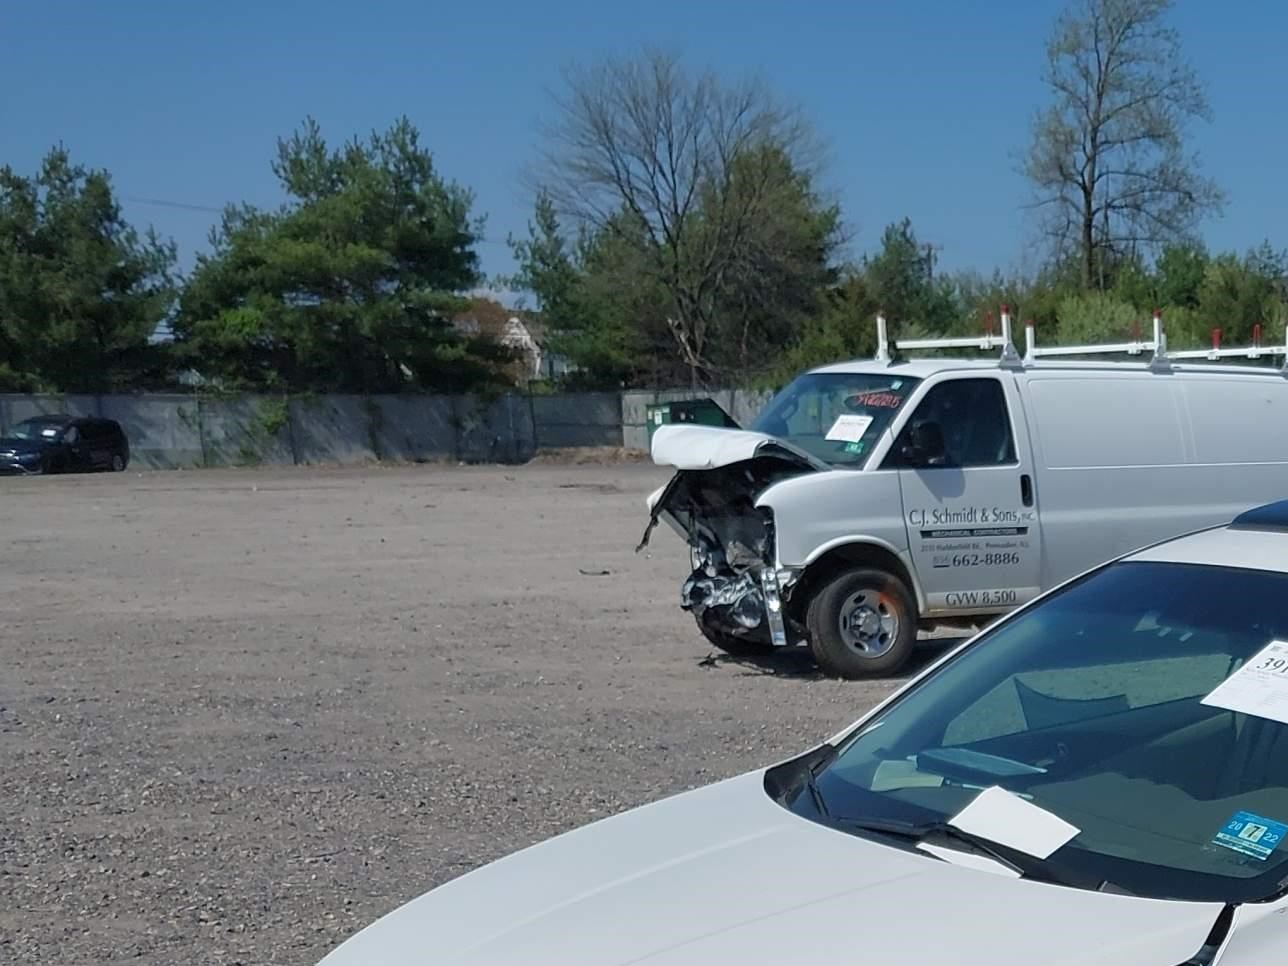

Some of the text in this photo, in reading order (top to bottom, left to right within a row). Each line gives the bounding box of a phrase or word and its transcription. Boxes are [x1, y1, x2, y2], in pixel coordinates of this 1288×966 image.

[909, 509, 929, 527] C.J.
[932, 507, 977, 524] Schmidt
[980, 508, 989, 522] &
[992, 507, 1021, 524] Sons,
[952, 552, 1020, 567] 662-8886
[945, 590, 1016, 605] GVW 8,500
[1228, 820, 1279, 844] 20 7 22
